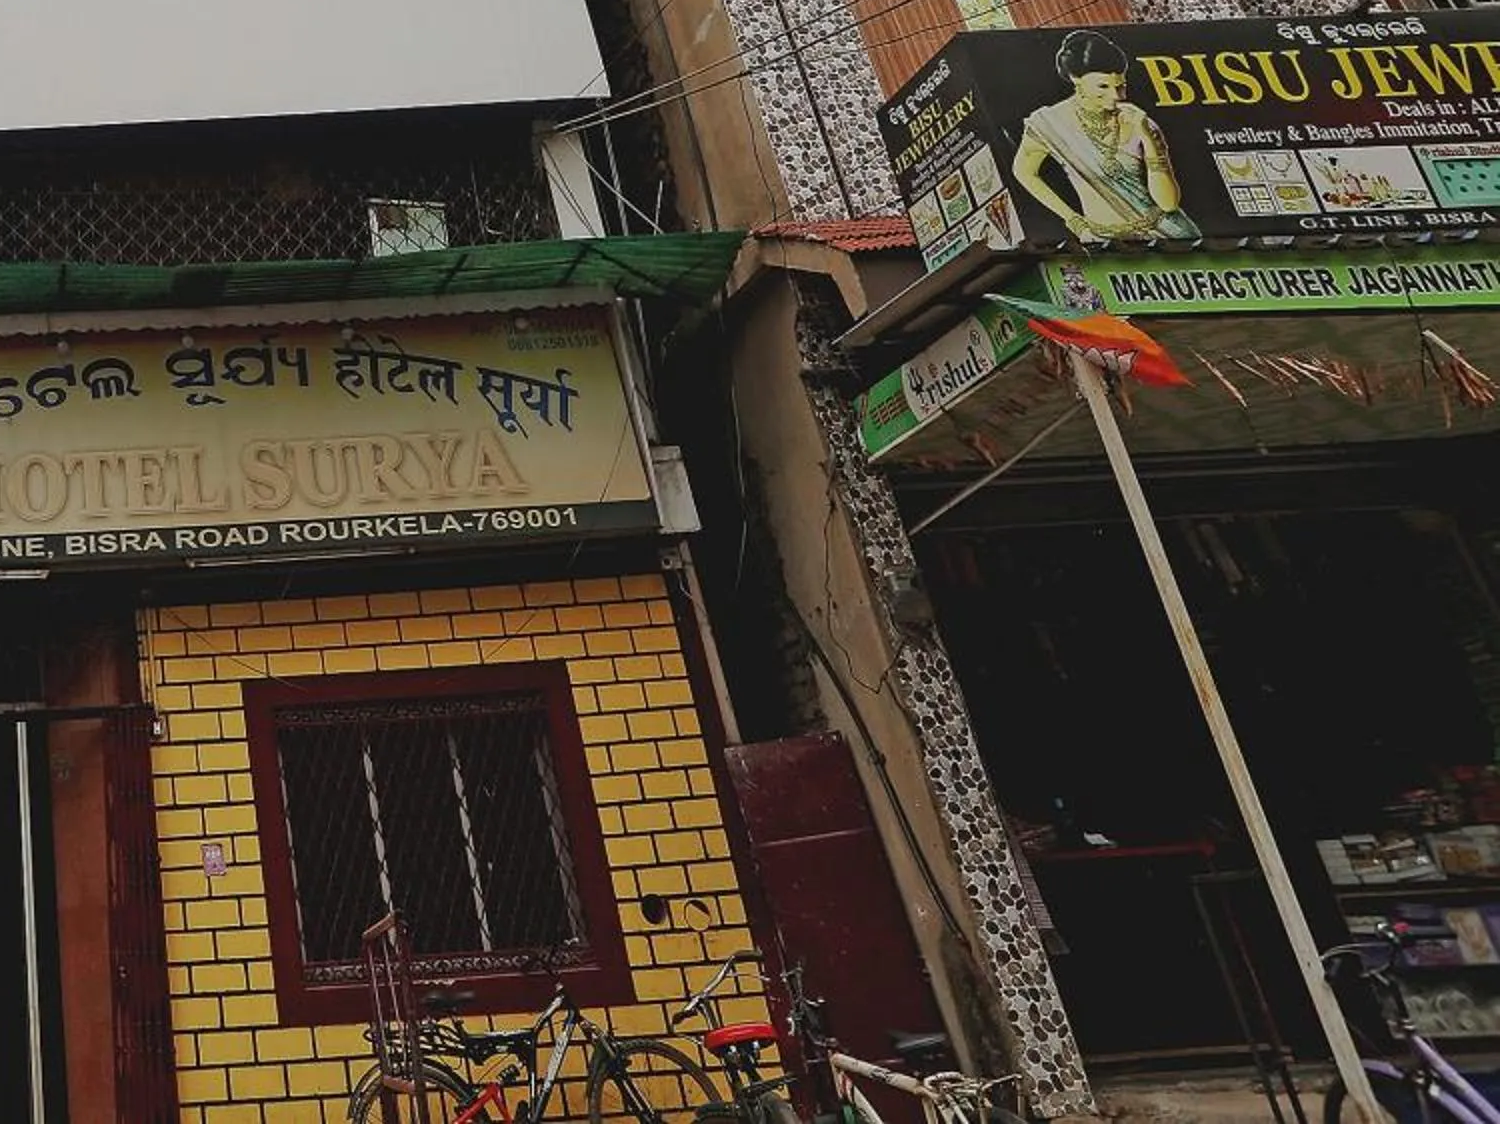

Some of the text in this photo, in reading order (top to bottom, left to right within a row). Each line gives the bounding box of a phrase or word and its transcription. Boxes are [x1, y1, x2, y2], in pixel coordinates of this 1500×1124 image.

[1135, 51, 1310, 107] BISU
[908, 99, 943, 139] BISU
[1382, 100, 1434, 117] Deals
[1437, 100, 1456, 115] in
[894, 89, 975, 175] JEWELLERY
[1204, 128, 1283, 147] Jewellery
[1287, 125, 1303, 141] &
[1306, 123, 1373, 145] Bangles
[1375, 119, 1480, 139] Immitation,
[1299, 216, 1346, 230] G.T.
[1352, 213, 1408, 228] LINE
[1424, 210, 1497, 226] BISRA
[1108, 265, 1343, 304] MANUFACTURER
[476, 367, 581, 440] सूर्या
[239, 427, 532, 512] SURYA
[64, 530, 167, 557] BISRA
[174, 525, 269, 549] ROAD
[279, 506, 579, 544] ROURKELA-769001
